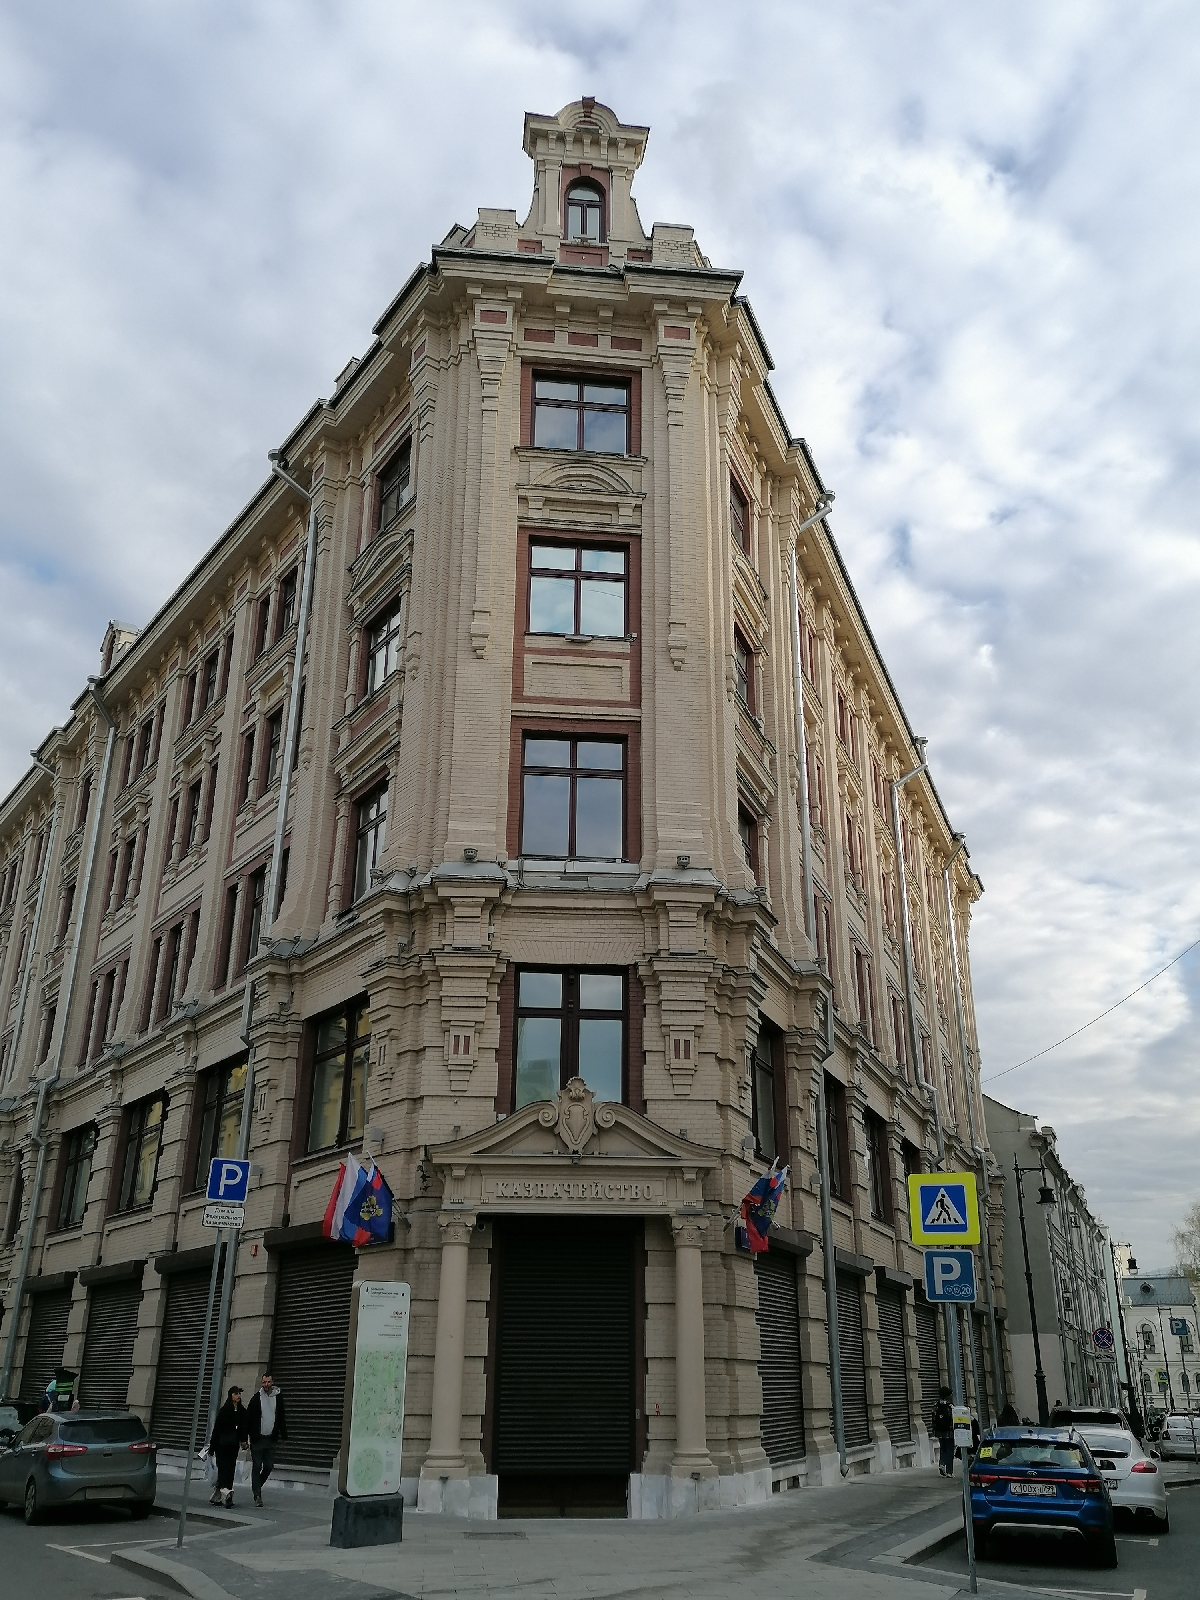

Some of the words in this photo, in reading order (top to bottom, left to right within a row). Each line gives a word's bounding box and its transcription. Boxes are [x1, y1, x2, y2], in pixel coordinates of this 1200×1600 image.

[219, 1164, 242, 1195] P
[496, 1181, 654, 1200] КАЗНАЧЕЙСТВО
[933, 1257, 961, 1294] P
[1171, 1320, 1182, 1333] P
